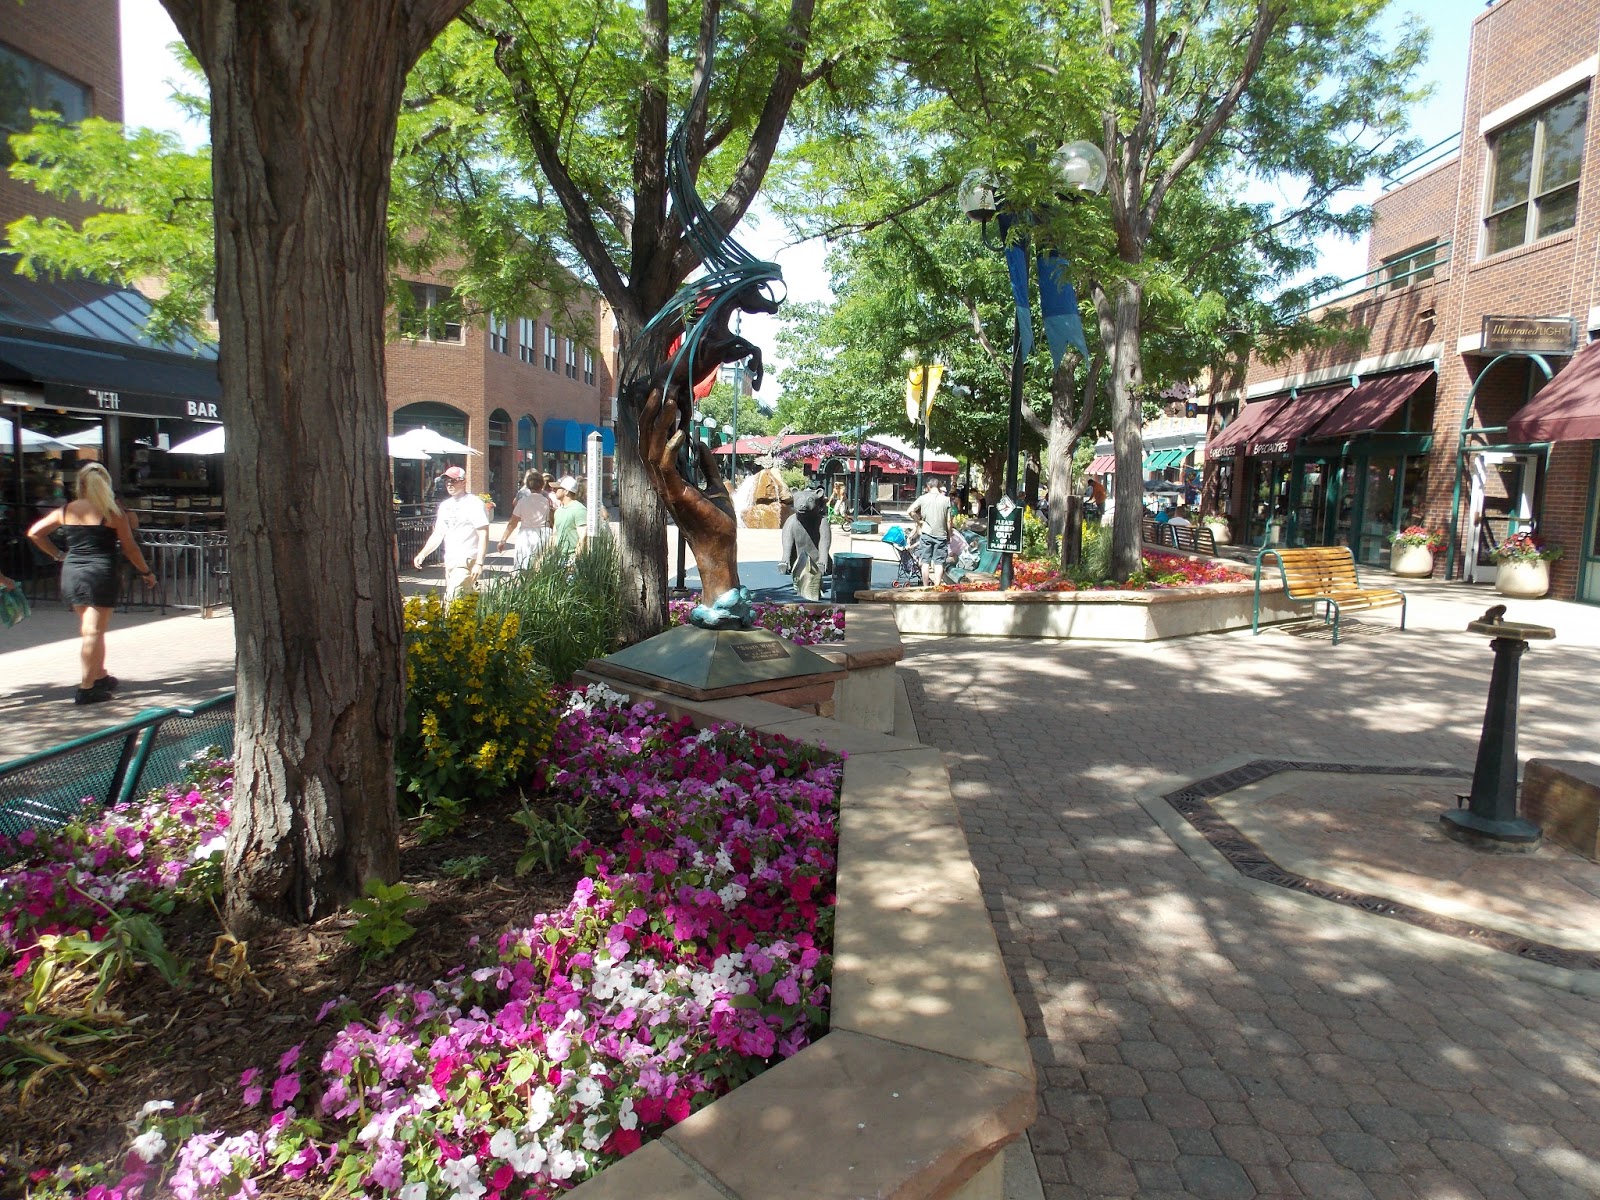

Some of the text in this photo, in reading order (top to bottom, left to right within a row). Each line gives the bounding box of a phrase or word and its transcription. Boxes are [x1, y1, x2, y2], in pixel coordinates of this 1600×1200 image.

[1492, 324, 1566, 336] Illustrated LIGHT
[97, 390, 120, 409] YETI
[186, 400, 218, 418] BAR
[1253, 441, 1289, 455] SPECIALTIES
[995, 531, 1013, 539] OUT
[991, 542, 1017, 550] PLANTERS
